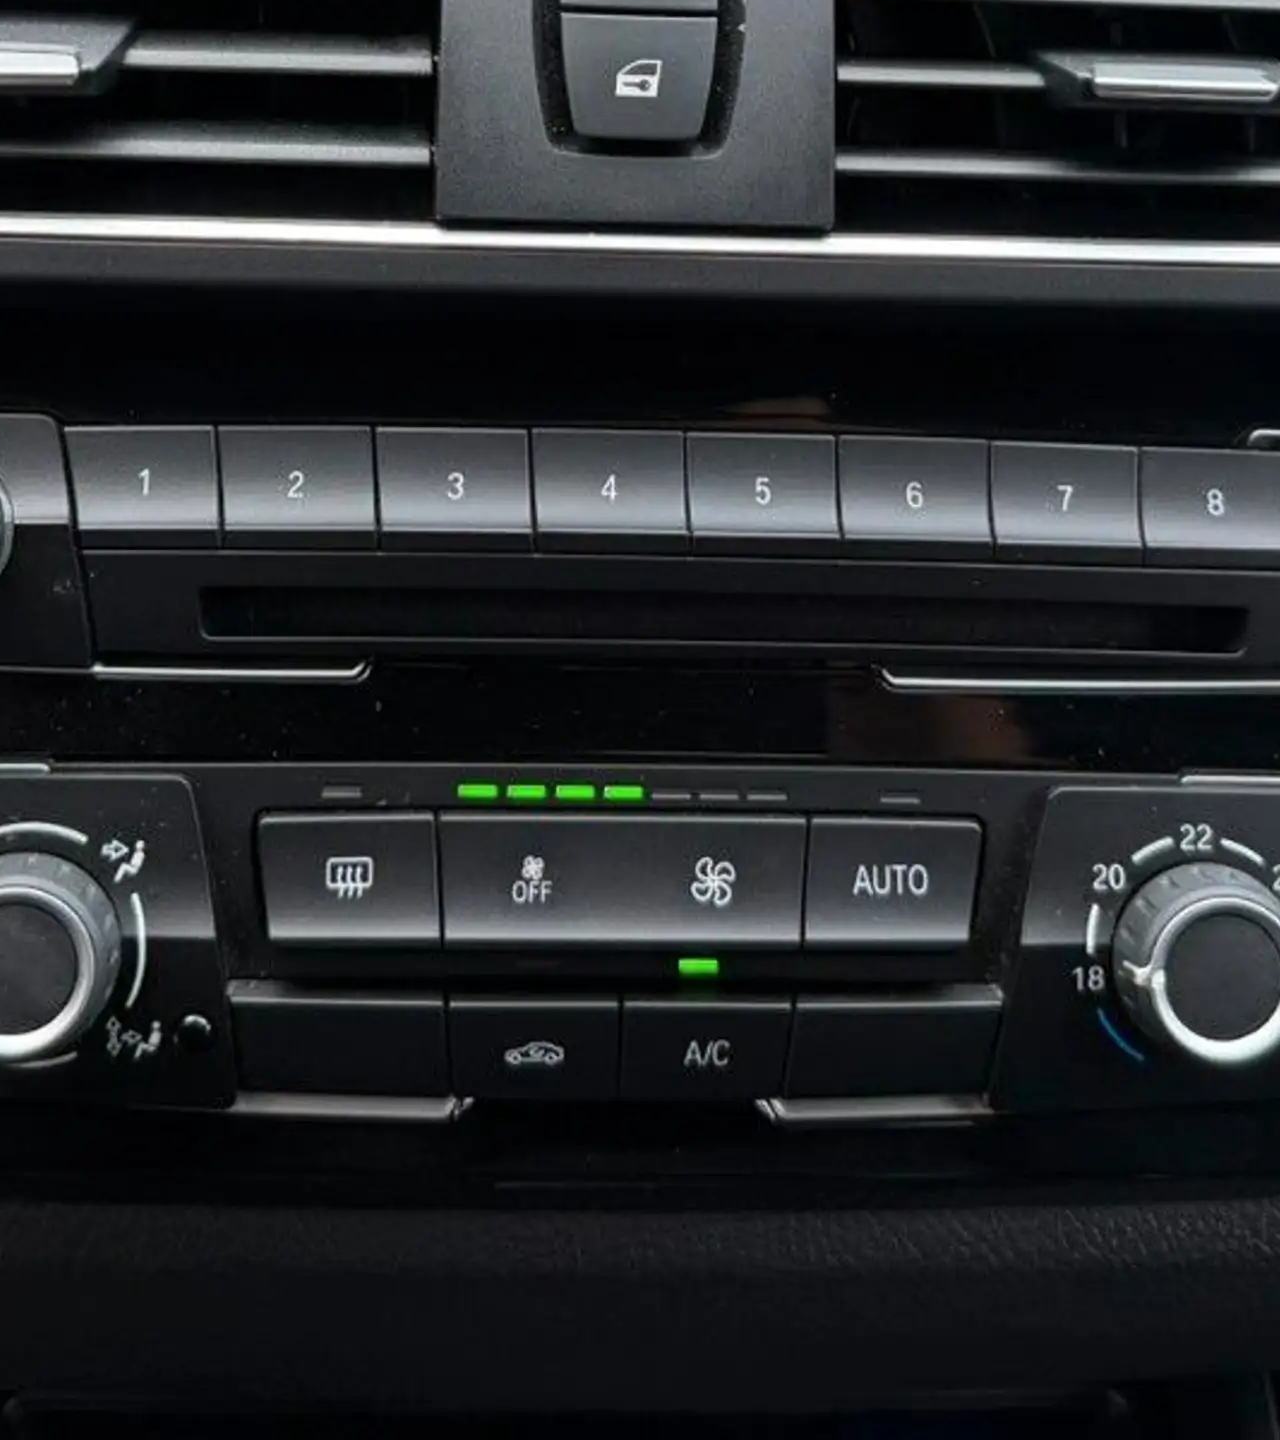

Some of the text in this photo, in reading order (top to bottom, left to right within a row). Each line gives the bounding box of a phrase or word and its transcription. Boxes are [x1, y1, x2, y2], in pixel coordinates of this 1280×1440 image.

[137, 470, 152, 496] 1
[286, 471, 306, 499] 2
[446, 472, 465, 500] 3
[600, 474, 619, 501] 4
[754, 477, 772, 505] 5
[905, 481, 924, 509] 6
[1056, 485, 1075, 512] 7
[1206, 488, 1226, 516] 8
[1179, 823, 1214, 852] 22
[852, 863, 929, 897] AUTO
[1092, 863, 1126, 891] 20
[511, 880, 552, 905] OFF
[1071, 965, 1105, 991] 18
[683, 1039, 731, 1067] A/C
